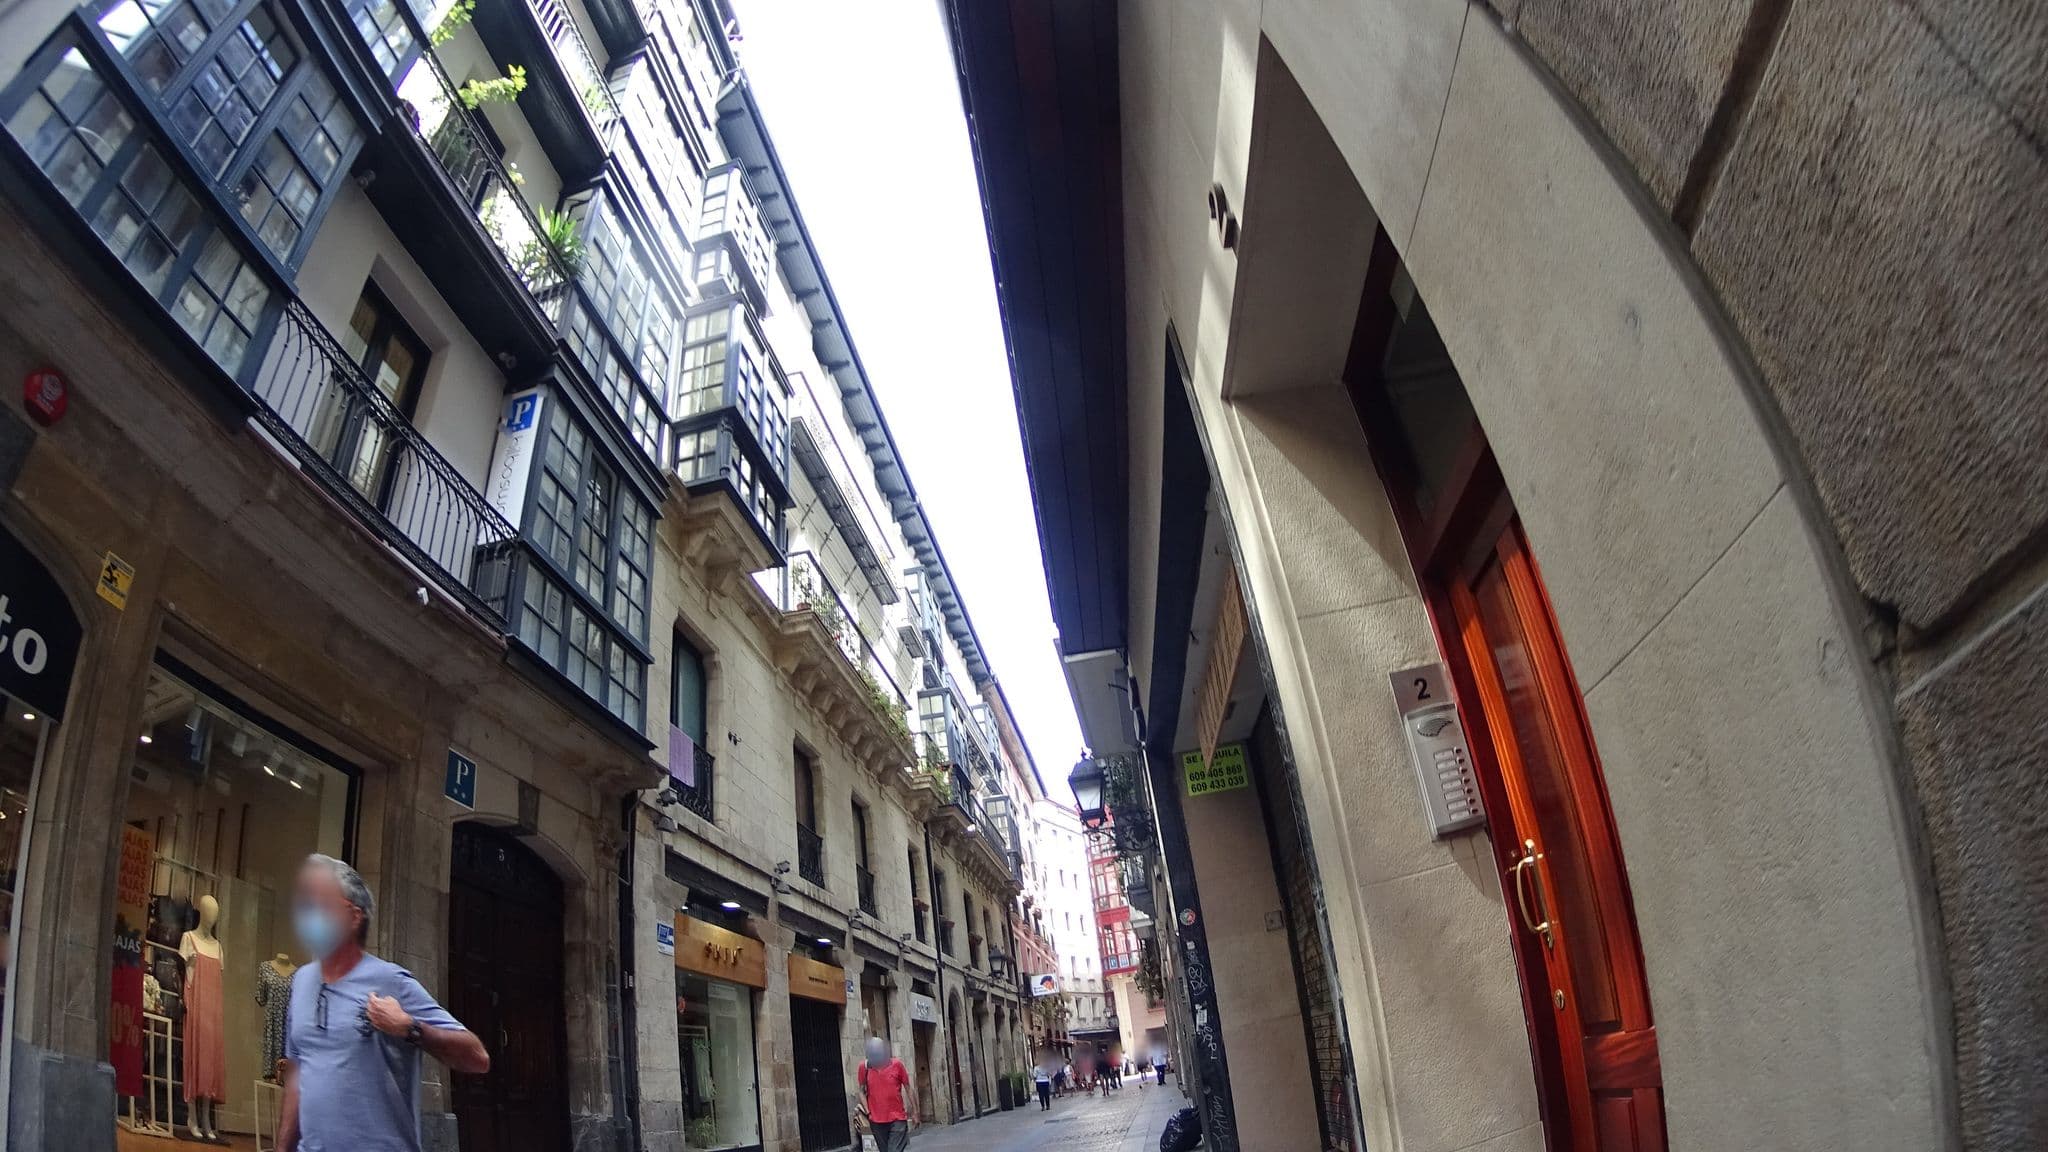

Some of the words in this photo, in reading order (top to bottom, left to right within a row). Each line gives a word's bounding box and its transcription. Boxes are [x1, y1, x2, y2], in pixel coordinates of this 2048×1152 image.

[512, 401, 531, 425] P
[1414, 678, 1431, 700] 2
[1186, 755, 1198, 764] SE
[456, 760, 469, 785] P
[1189, 771, 1206, 782] 609
[1191, 782, 1207, 793] 609
[1210, 779, 1226, 790] 433
[1228, 776, 1245, 787] 039
